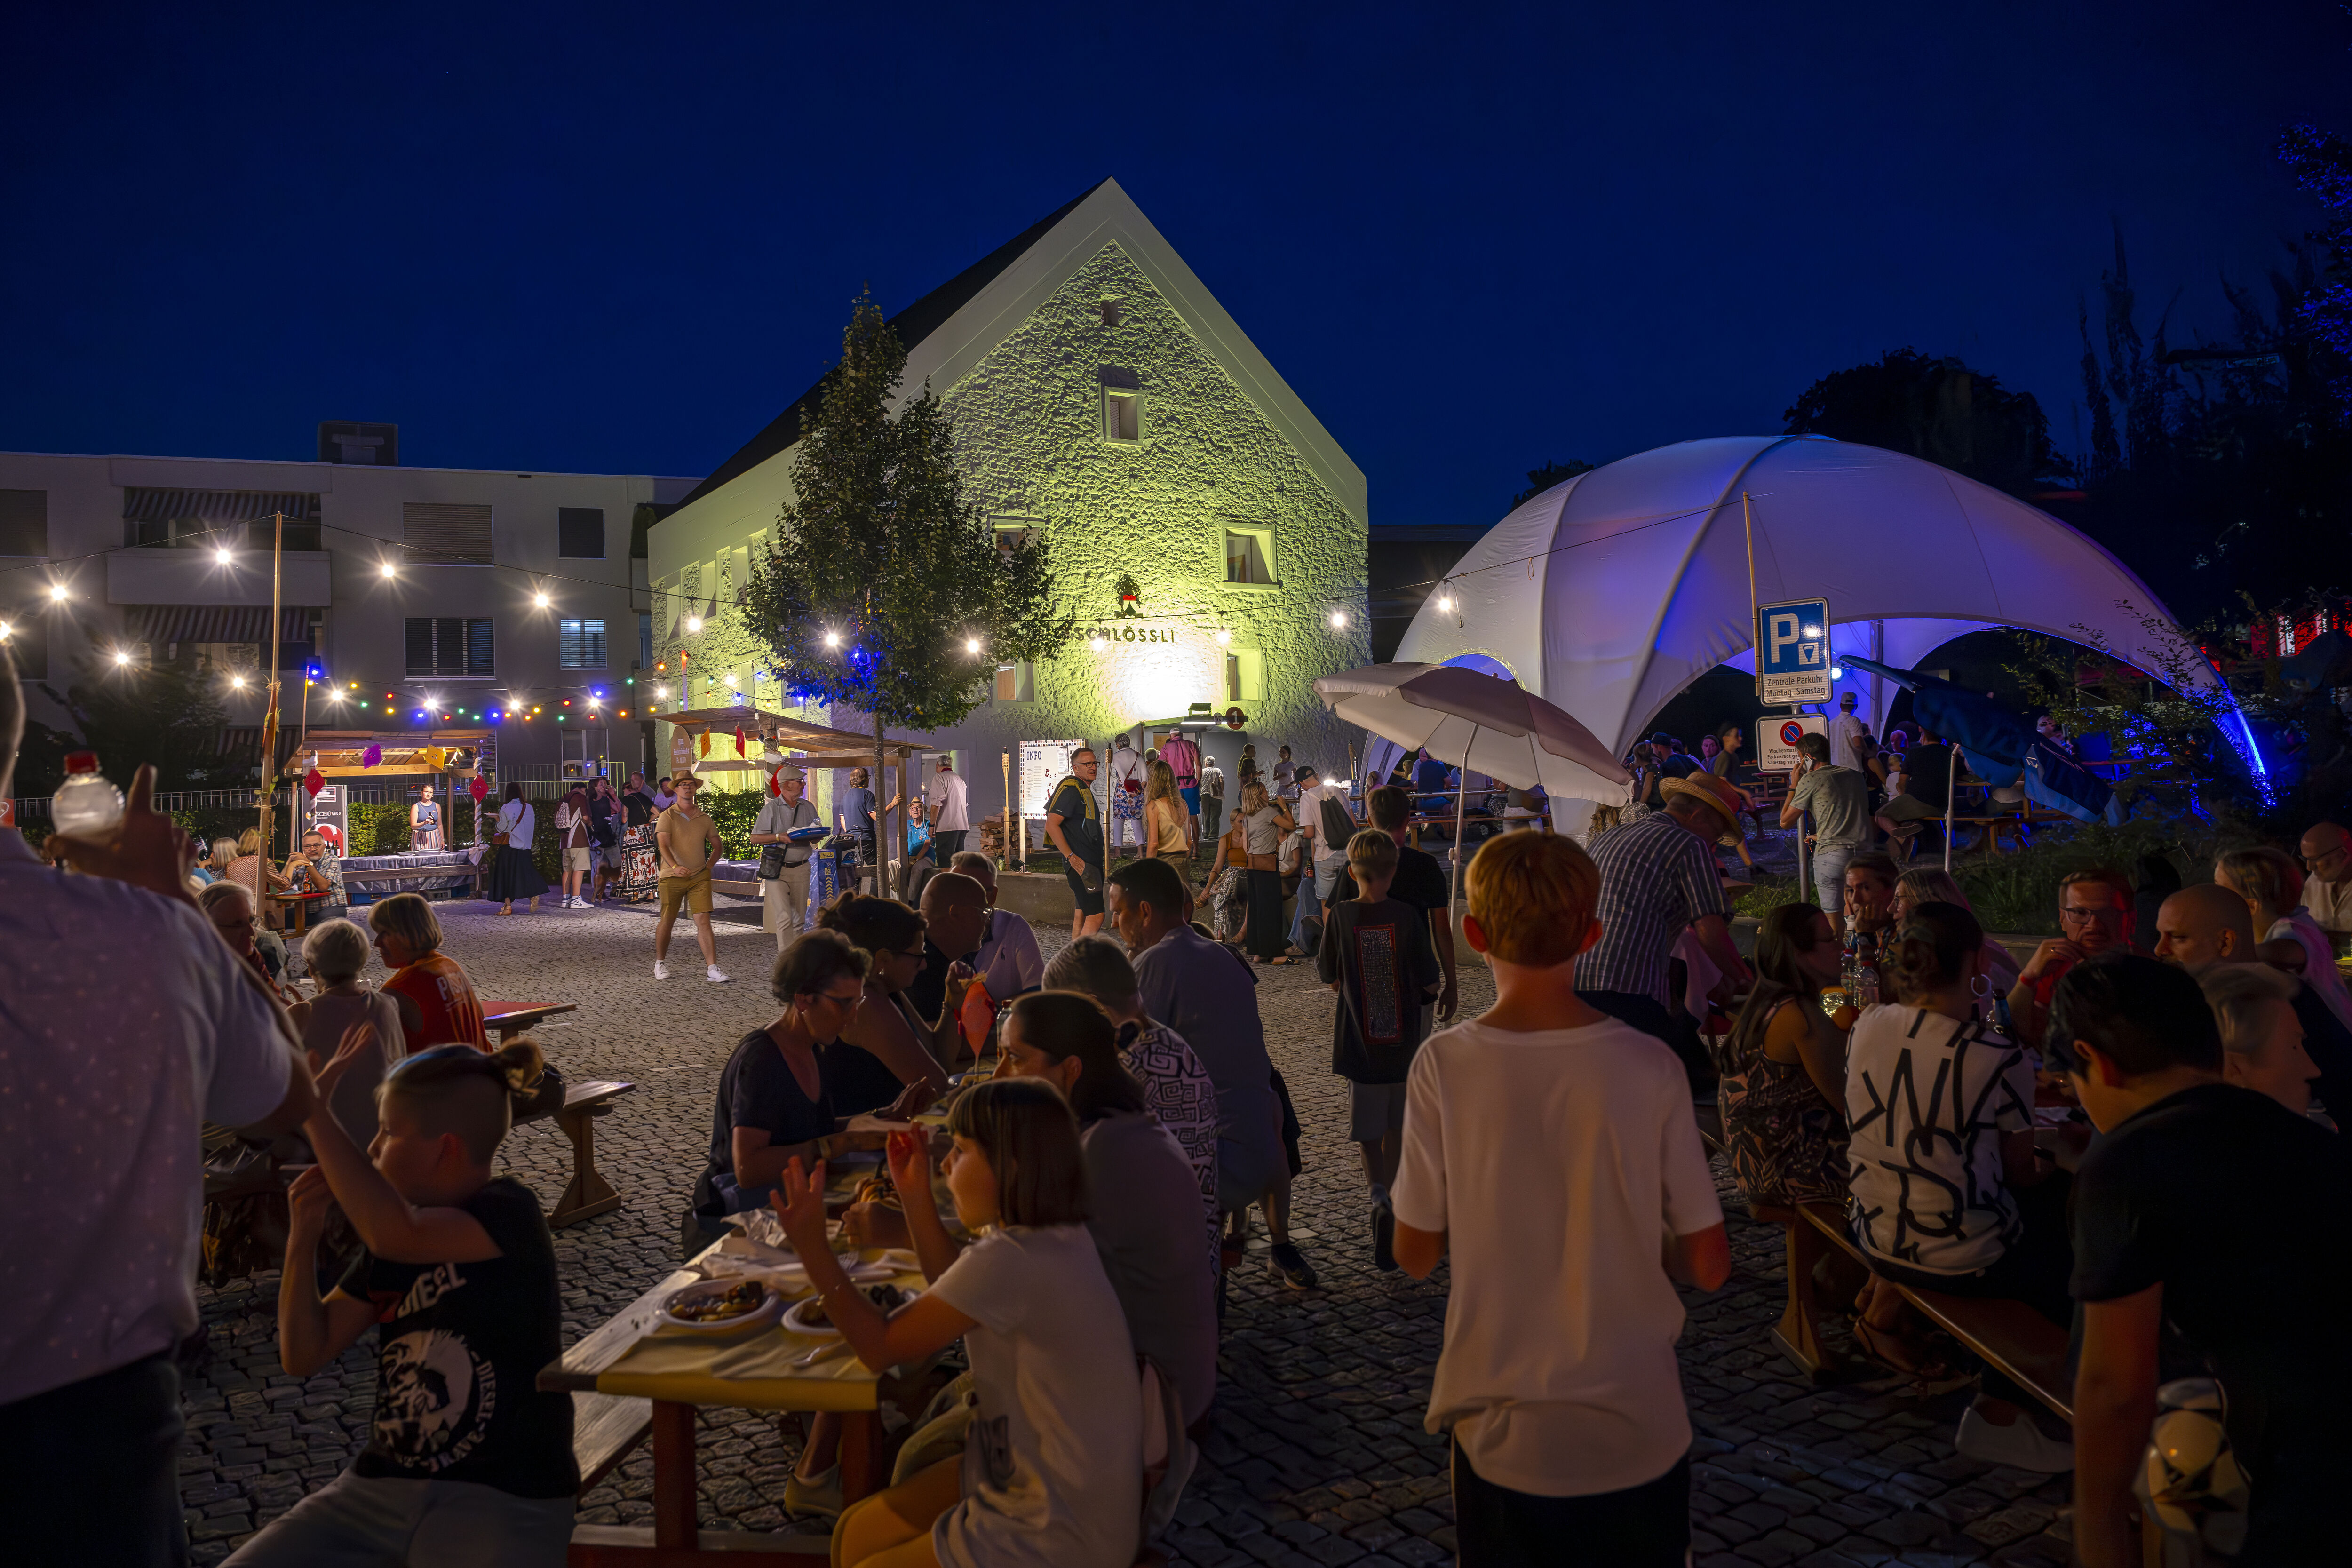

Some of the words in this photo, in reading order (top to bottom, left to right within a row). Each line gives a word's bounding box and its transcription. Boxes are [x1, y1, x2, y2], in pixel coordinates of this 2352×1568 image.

[1073, 625, 1174, 643] SCHLÖSSLI
[1770, 613, 1799, 663] P
[1768, 677, 1795, 686] Zentrale
[1797, 675, 1823, 684] Parkuhr
[1232, 711, 1239, 725] 1
[1027, 751, 1041, 760] INFO
[475, 1359, 496, 1423] DIESEL
